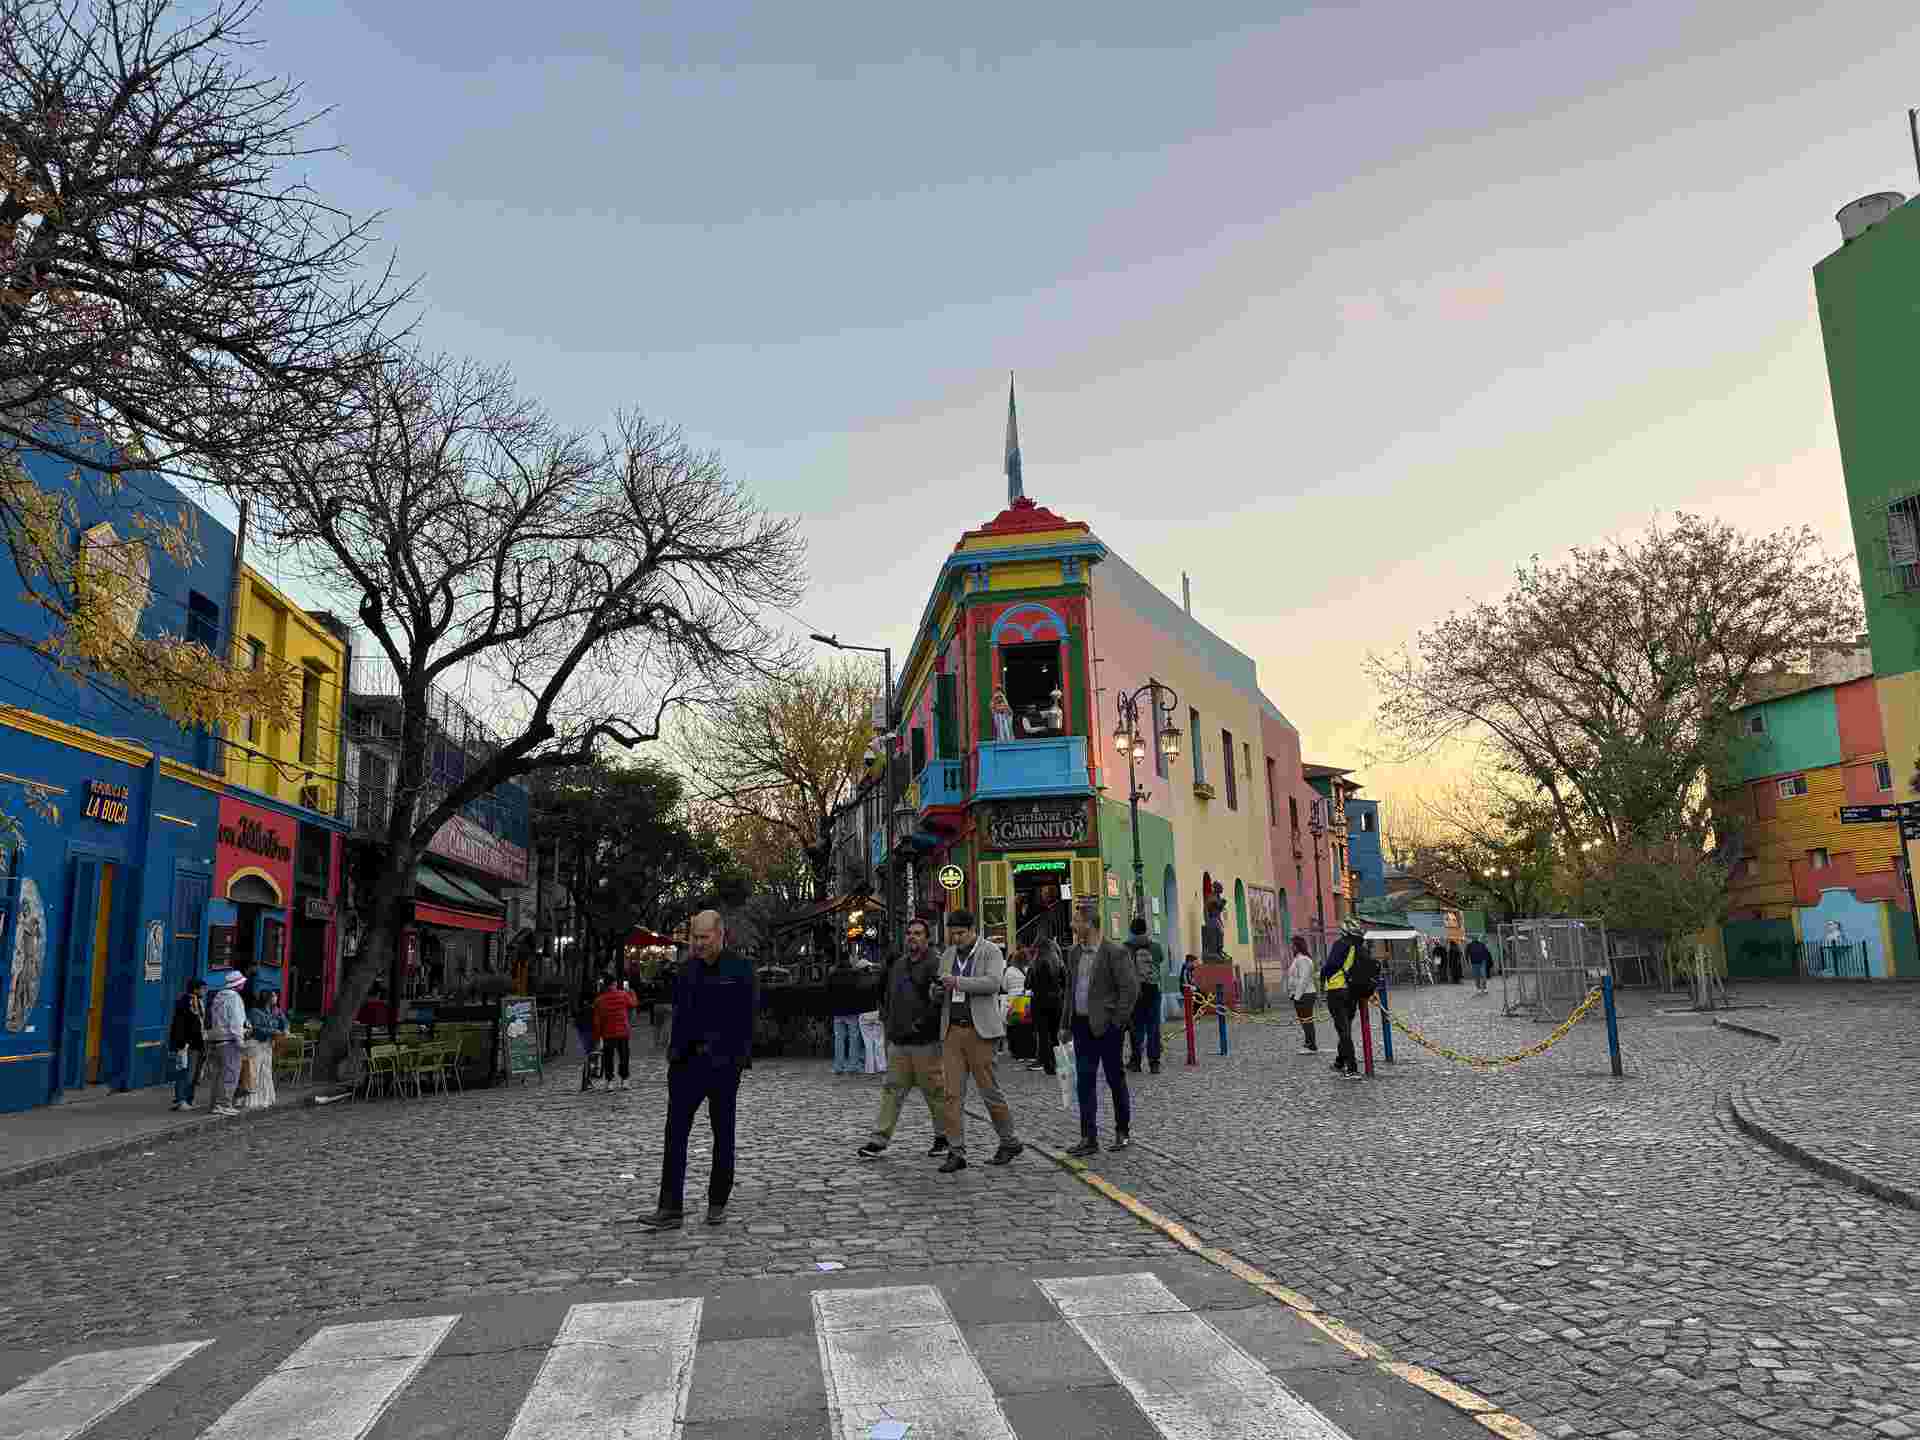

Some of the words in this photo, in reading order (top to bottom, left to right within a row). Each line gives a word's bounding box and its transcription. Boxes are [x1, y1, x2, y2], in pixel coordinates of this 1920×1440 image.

[86, 795, 101, 817] LA
[101, 799, 128, 825] BOCA
[1001, 820, 1075, 840] CAMINITO
